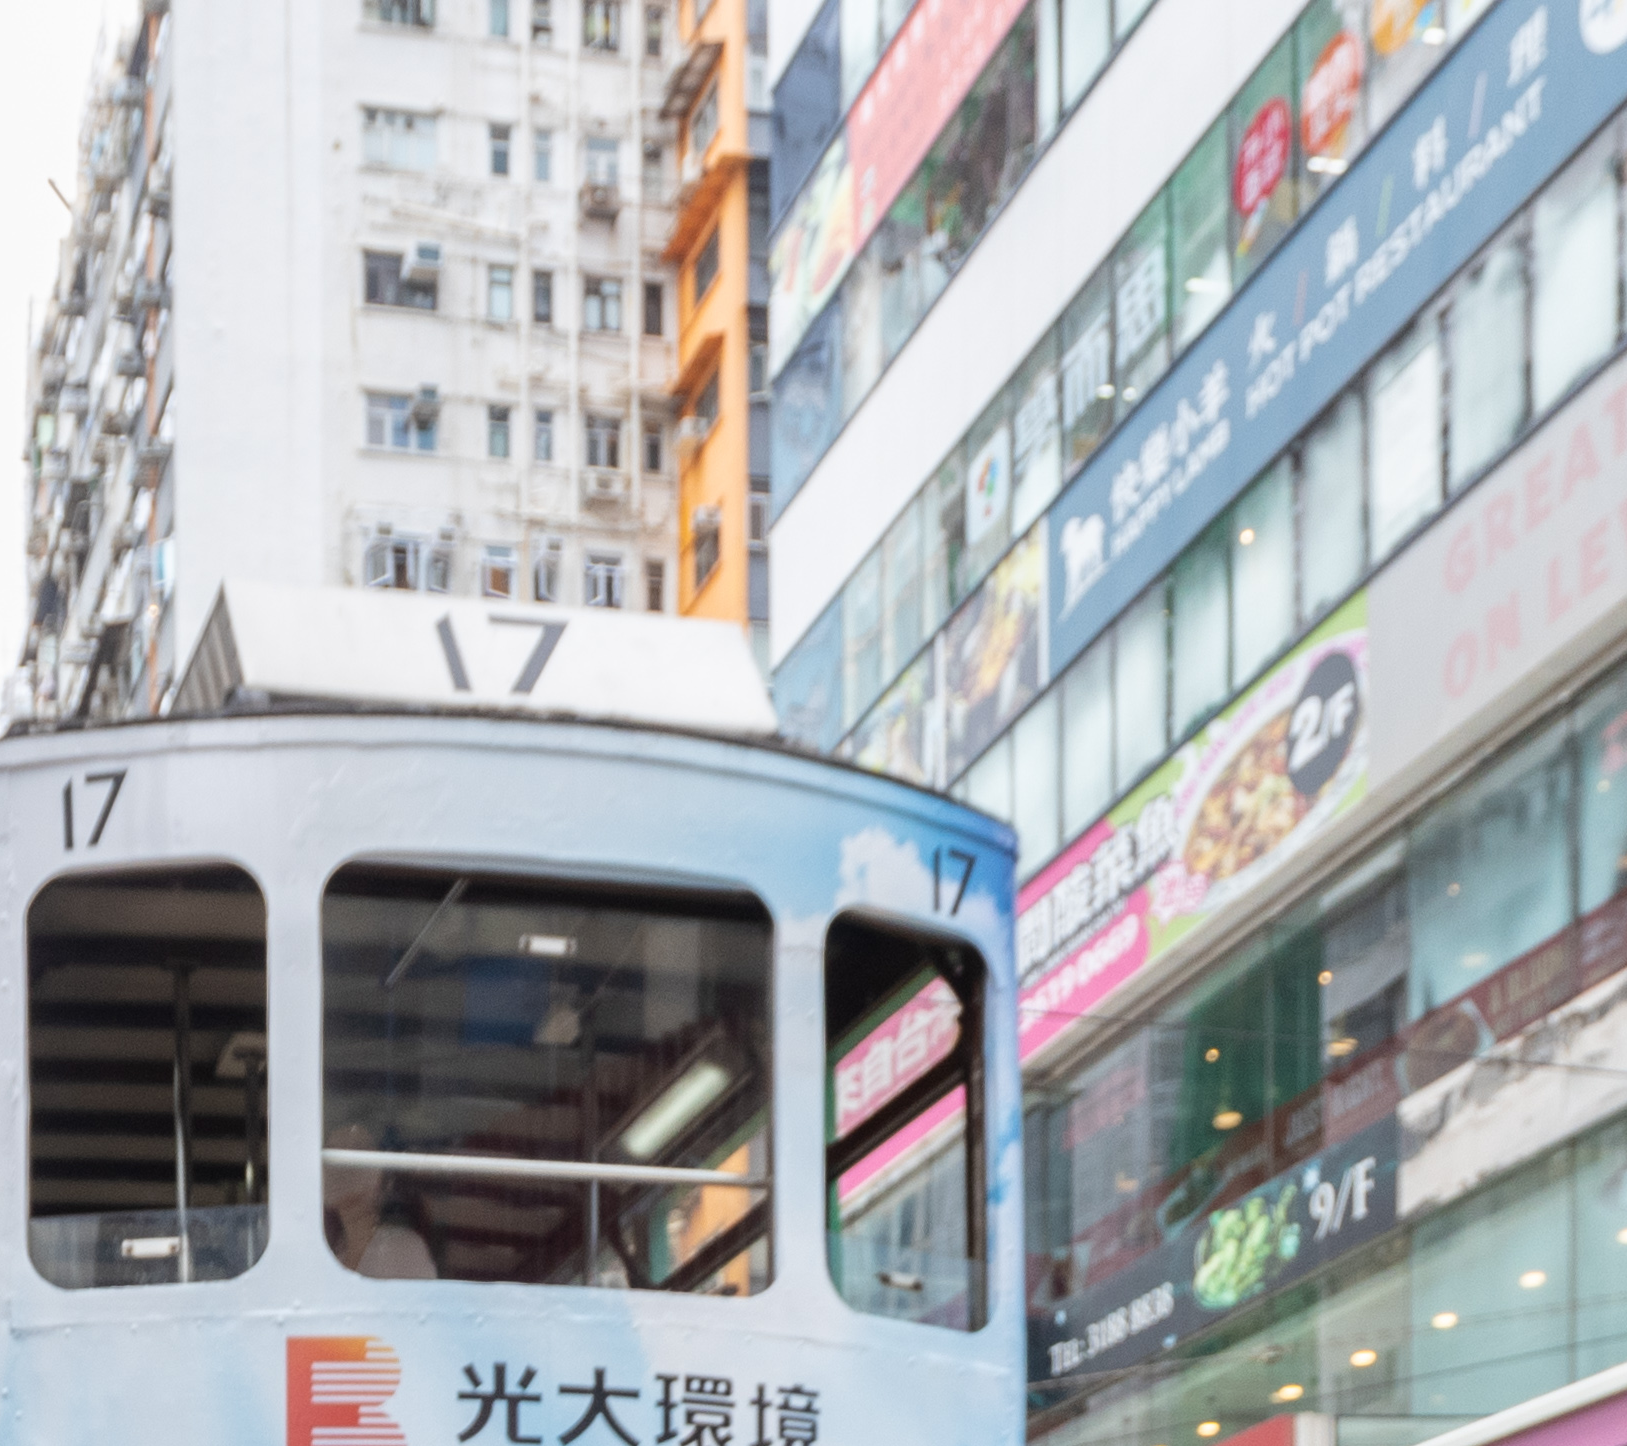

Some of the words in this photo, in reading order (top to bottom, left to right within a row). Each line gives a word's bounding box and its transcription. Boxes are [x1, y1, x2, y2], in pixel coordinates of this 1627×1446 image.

[1298, 286, 1350, 363] POT
[1353, 76, 1546, 305] RESTAURANT
[434, 615, 571, 696] 17
[1442, 592, 1523, 700] ON
[1289, 680, 1357, 774] 2/F
[62, 768, 129, 851] 17
[932, 846, 976, 918] 17
[1308, 1156, 1377, 1243] 9/F
